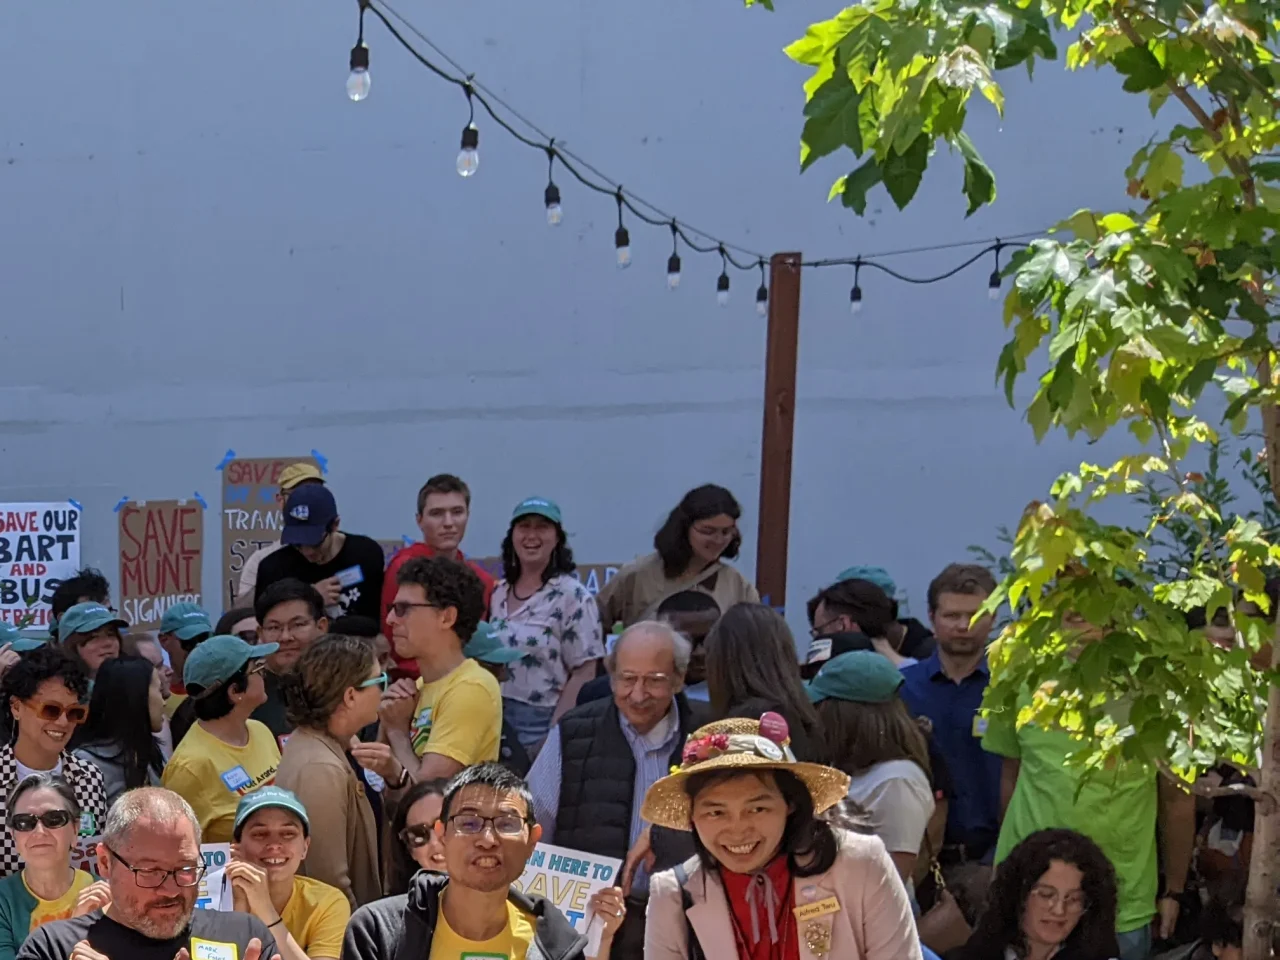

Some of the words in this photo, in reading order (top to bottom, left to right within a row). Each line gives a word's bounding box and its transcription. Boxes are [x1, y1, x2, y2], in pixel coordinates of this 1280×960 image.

[228, 462, 282, 484] SAVE
[43, 510, 78, 532] OUR
[224, 509, 284, 531] TRANS
[122, 506, 200, 562] SAVE
[10, 563, 47, 577] AND
[122, 552, 194, 596] MUNI
[1, 578, 60, 604] BUS
[124, 597, 165, 626] SIGN
[203, 850, 226, 866] TO
[548, 854, 588, 878] HERE
[592, 862, 613, 882] TO
